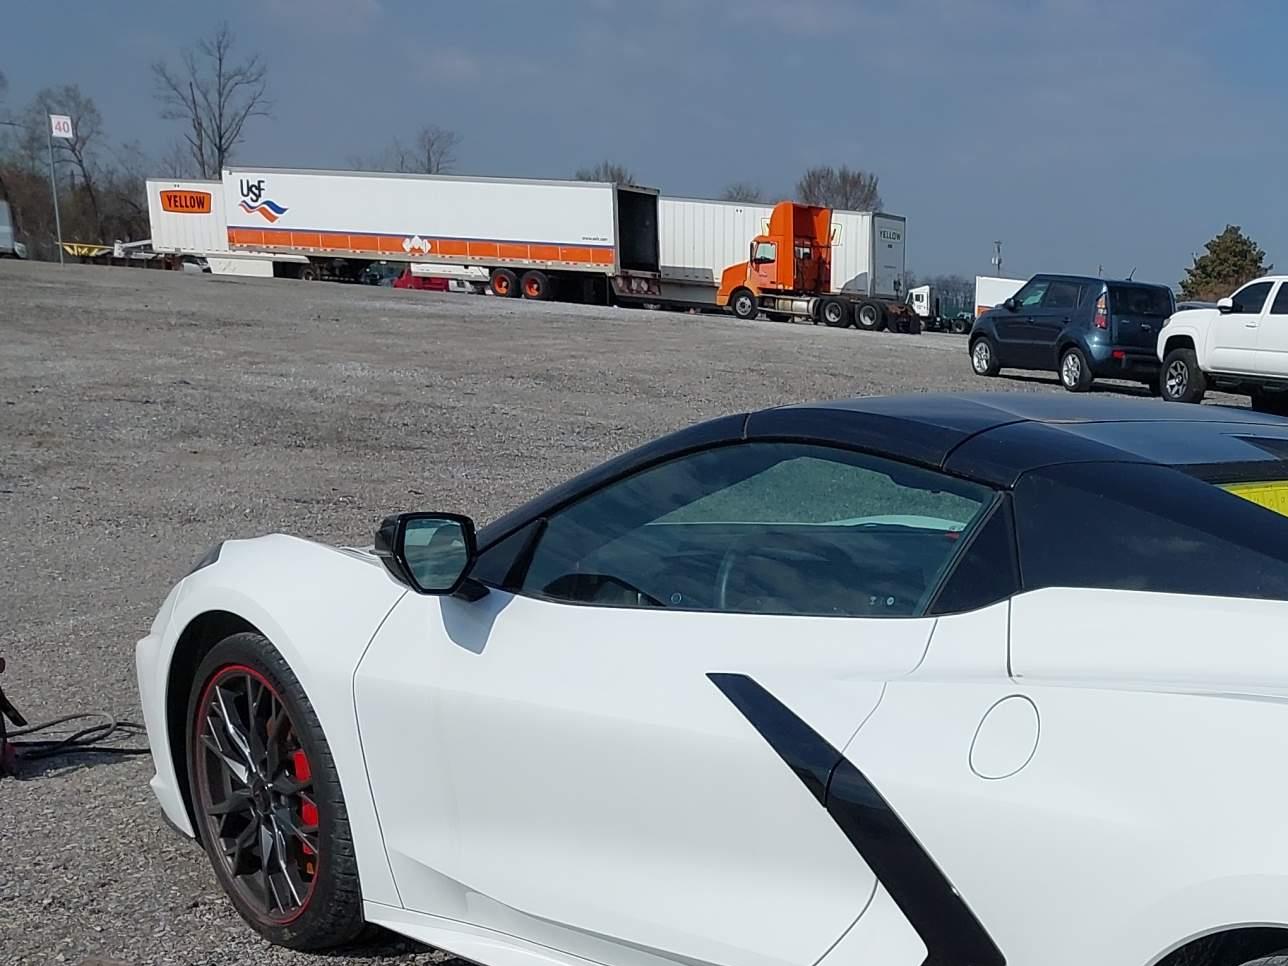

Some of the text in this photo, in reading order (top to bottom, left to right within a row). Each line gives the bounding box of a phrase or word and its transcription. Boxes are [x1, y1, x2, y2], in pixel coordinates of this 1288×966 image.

[54, 120, 70, 133] 40
[240, 179, 265, 203] USF
[166, 194, 205, 209] YELLOW
[879, 230, 901, 241] YELLOW
